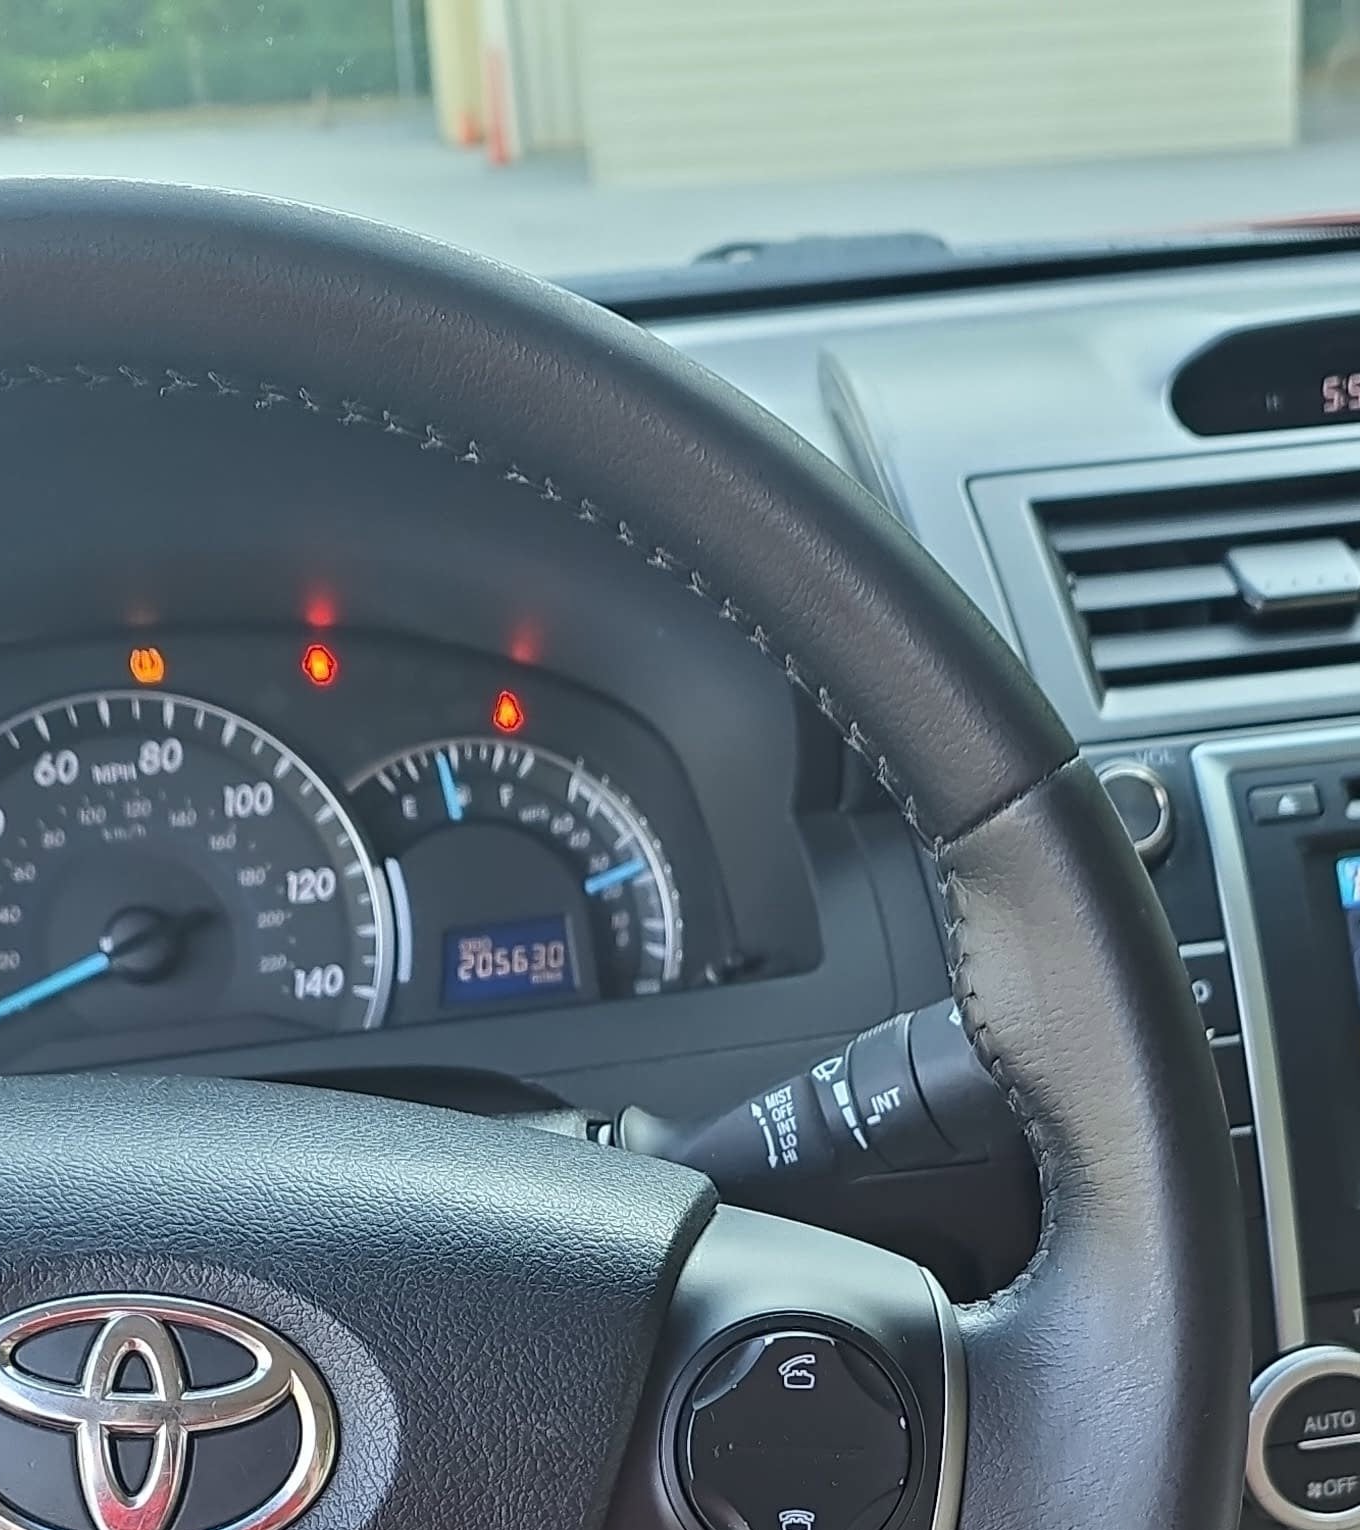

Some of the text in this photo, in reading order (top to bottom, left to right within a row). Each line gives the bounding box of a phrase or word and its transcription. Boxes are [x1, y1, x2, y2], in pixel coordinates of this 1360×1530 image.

[33, 750, 79, 787] 60
[139, 738, 184, 775] 80
[91, 762, 138, 785] MPH
[223, 782, 274, 818] 100
[287, 867, 337, 904] 120
[457, 941, 565, 982] 205630
[294, 964, 345, 999] 140
[764, 1085, 792, 1111] MIST
[871, 1086, 901, 1116] INT
[771, 1101, 795, 1122] OFF
[776, 1116, 798, 1137] INT
[779, 1132, 798, 1151] LO
[782, 1148, 799, 1165] HI
[1303, 1411, 1356, 1433] AUTO
[1323, 1475, 1360, 1497] OFF
